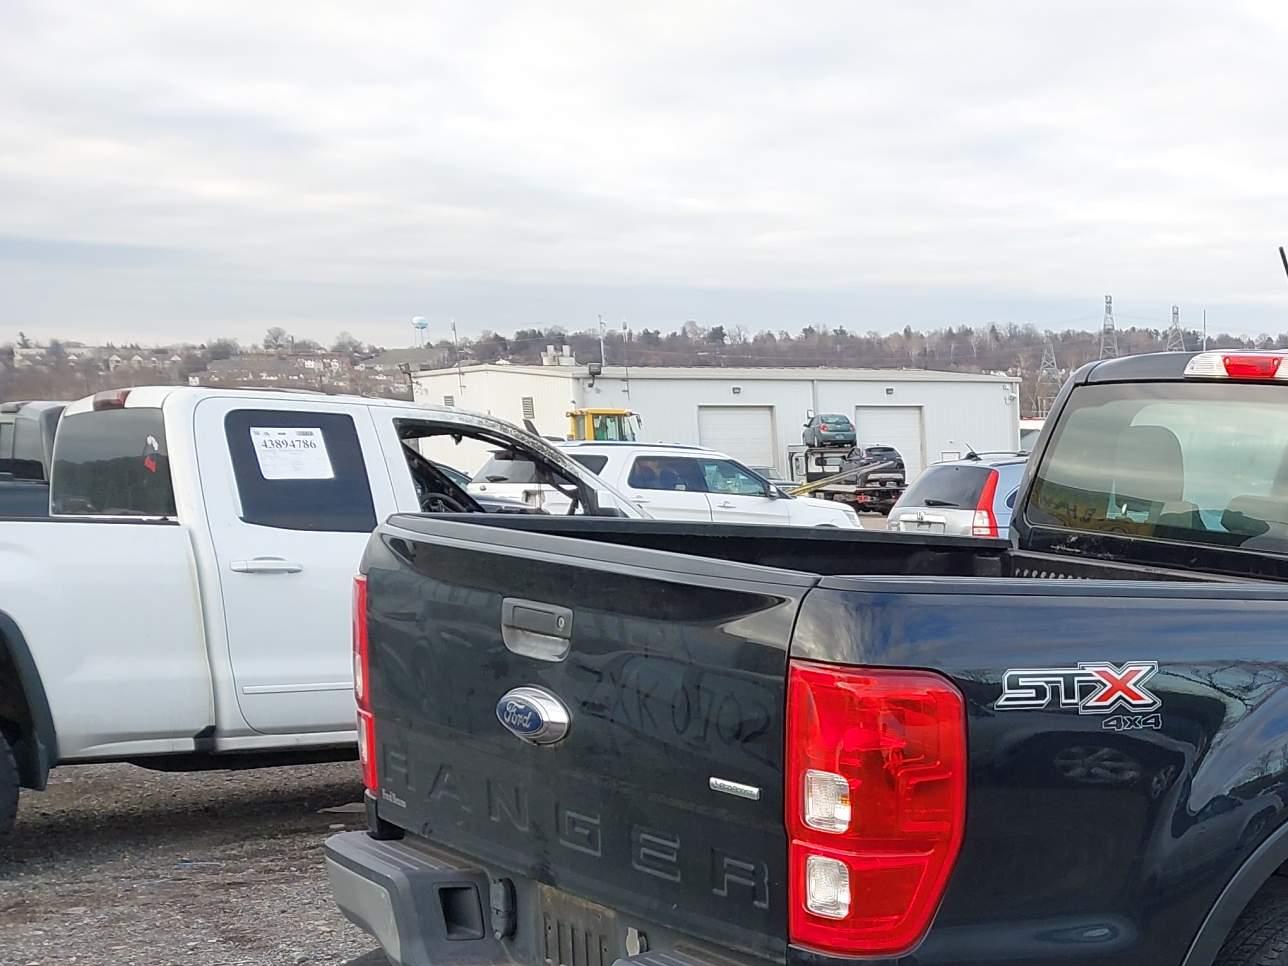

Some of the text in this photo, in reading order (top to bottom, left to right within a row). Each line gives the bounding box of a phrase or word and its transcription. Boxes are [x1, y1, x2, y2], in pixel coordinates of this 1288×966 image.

[261, 439, 317, 449] 43894786
[994, 660, 1162, 715] STX
[503, 700, 533, 729] Ford
[1102, 713, 1163, 731] 4x4
[380, 743, 770, 910] RANGER
